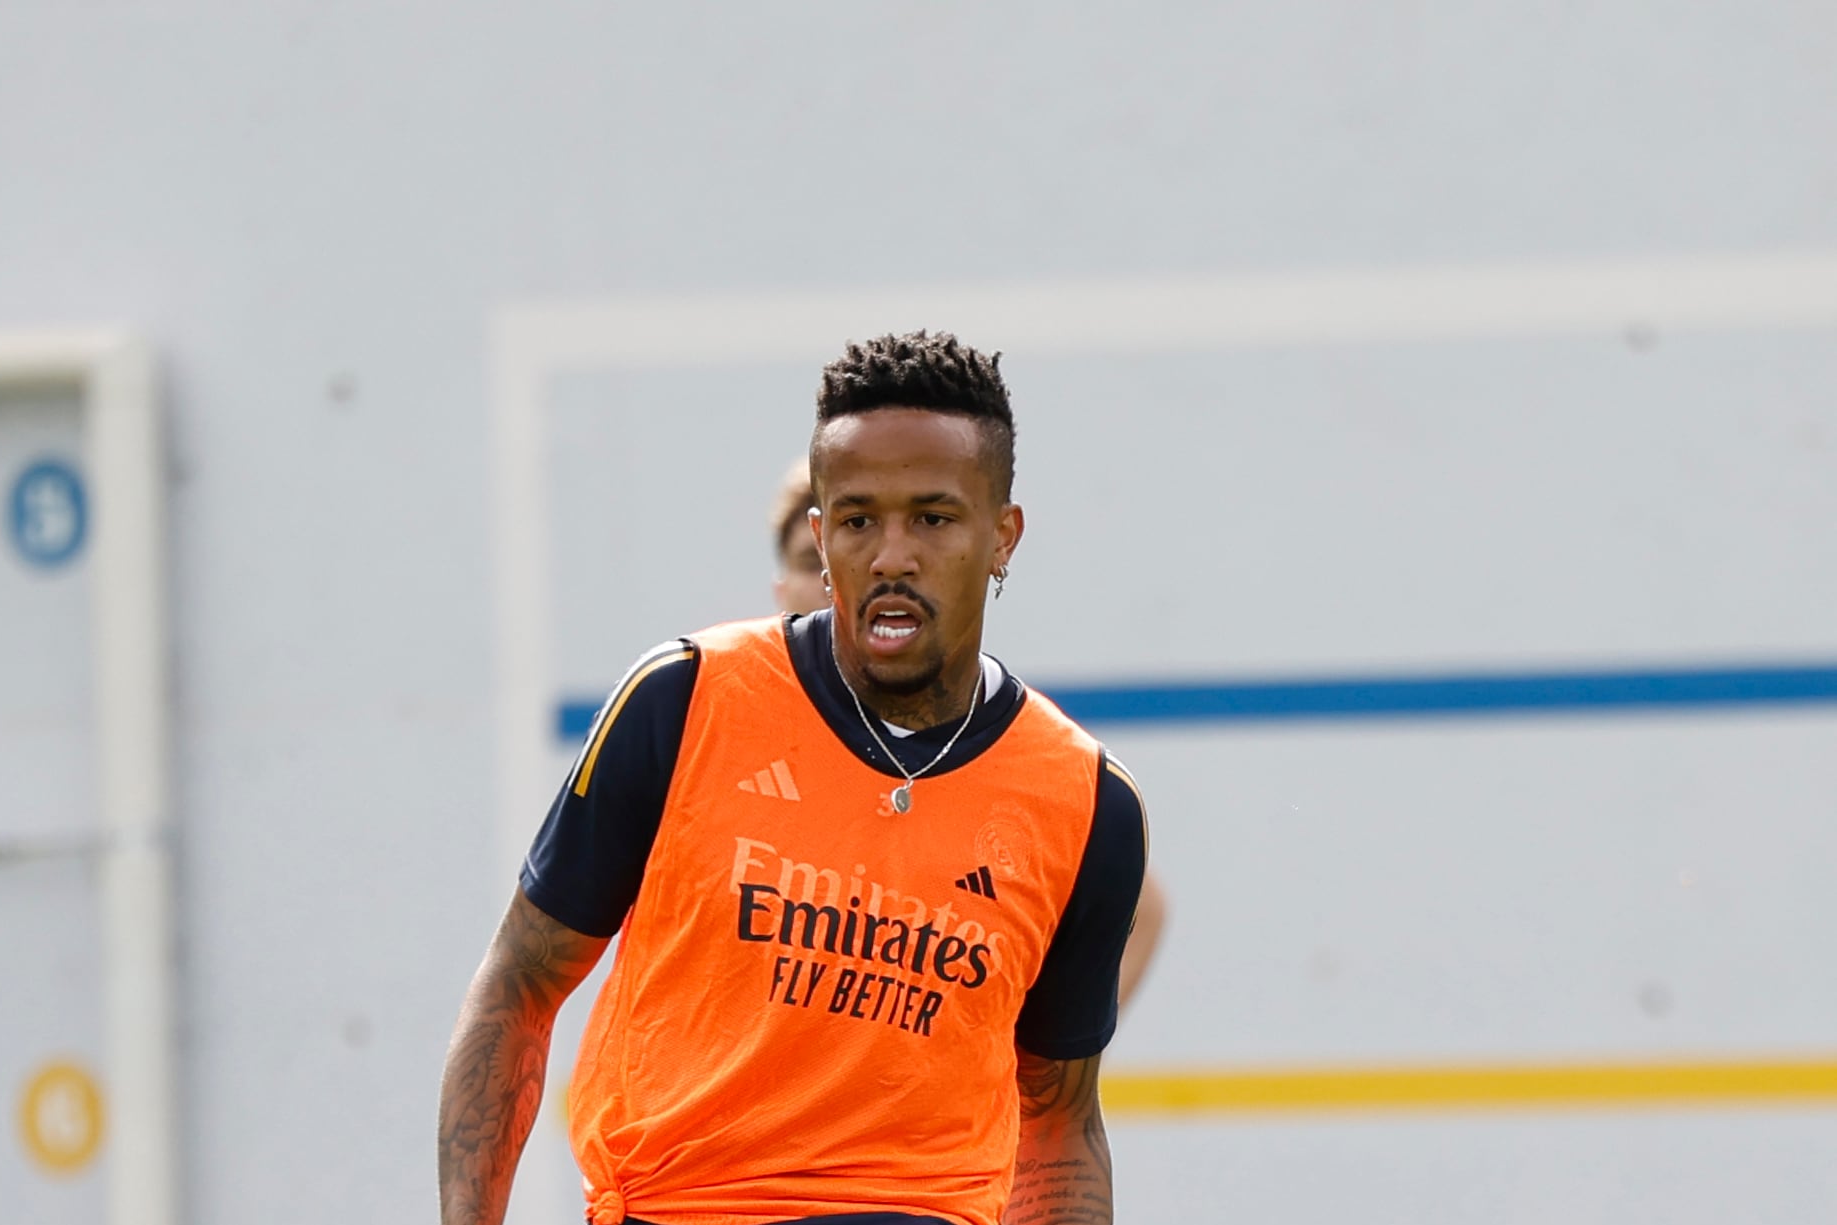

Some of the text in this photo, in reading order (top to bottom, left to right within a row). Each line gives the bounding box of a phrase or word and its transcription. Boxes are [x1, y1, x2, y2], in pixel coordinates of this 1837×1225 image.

[738, 883, 990, 988] Emirates
[769, 956, 942, 1036] FLY BETTER
